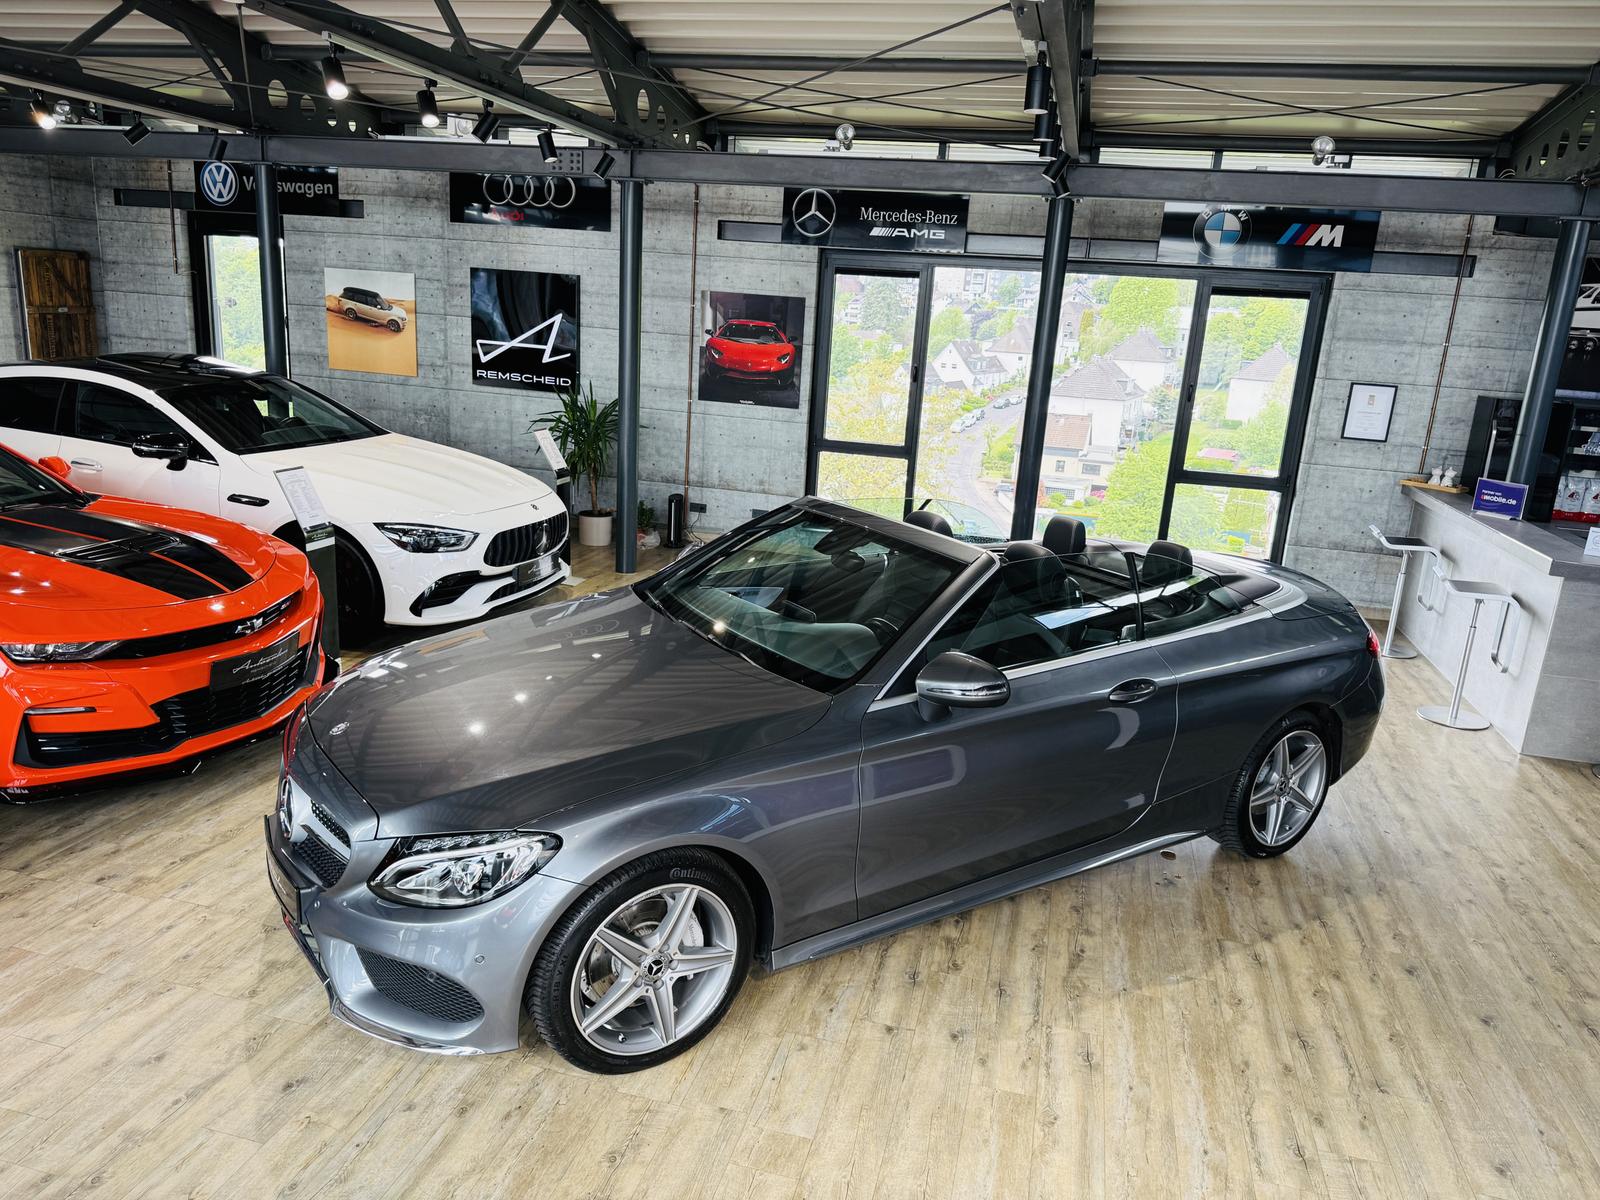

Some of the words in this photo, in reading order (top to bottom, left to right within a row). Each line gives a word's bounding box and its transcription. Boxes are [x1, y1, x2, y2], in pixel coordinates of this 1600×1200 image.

[243, 175, 333, 198] Vswagen
[860, 207, 958, 225] Mercedes-Benz
[891, 228, 946, 240] AMG
[476, 369, 572, 387] REMSCHEID
